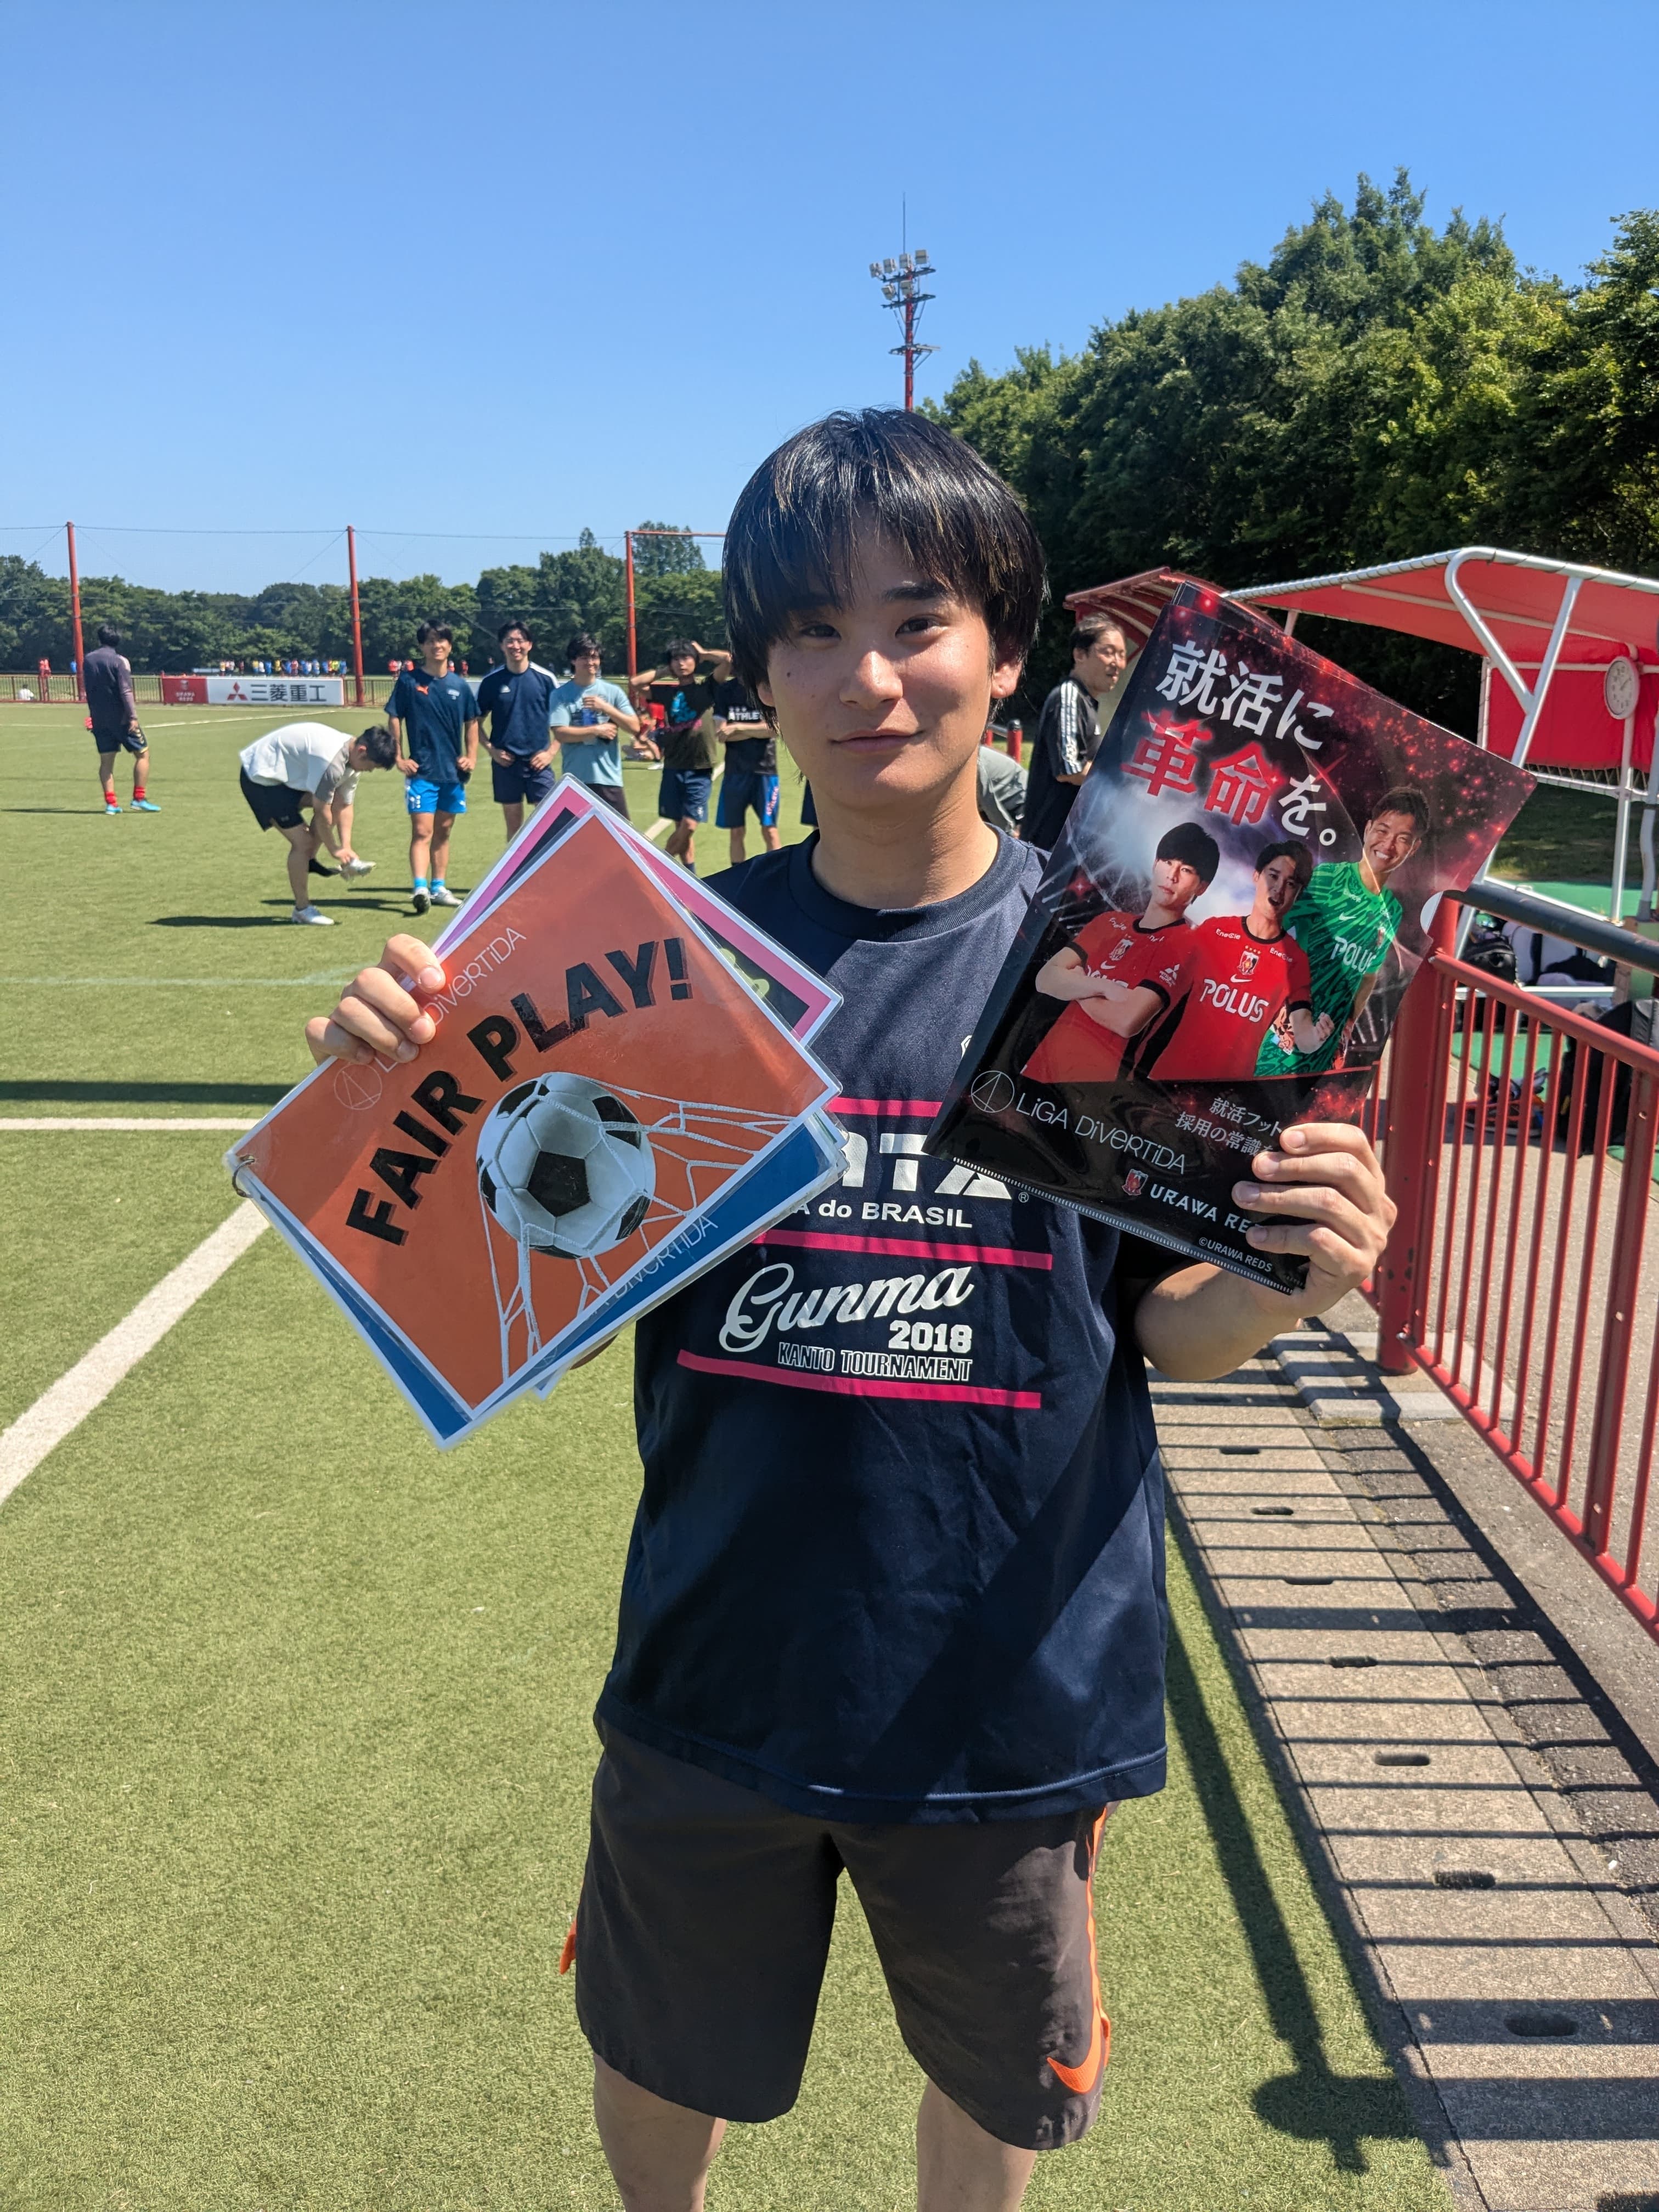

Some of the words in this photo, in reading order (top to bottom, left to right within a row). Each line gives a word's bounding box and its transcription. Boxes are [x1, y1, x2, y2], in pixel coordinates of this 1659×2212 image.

[250, 684, 326, 702] 三菱重工
[1155, 640, 1335, 750] 就活に
[728, 710, 761, 720] ATHLE
[1120, 707, 1336, 846] 革命を。
[1199, 978, 1269, 1023] POLUS
[346, 1070, 486, 1246] FAIR
[466, 937, 693, 1082] PLAY!
[818, 1199, 852, 1218] do
[861, 1203, 973, 1228] BRASIL
[1149, 1183, 1218, 1222] URAWA
[1224, 1212, 1265, 1233] RE
[1244, 1255, 1273, 1273] REDS
[719, 1262, 975, 1352] Gunma
[888, 1319, 973, 1353] 2018
[777, 1341, 835, 1371] KANTO
[840, 1350, 973, 1381] TOURNAMENT
